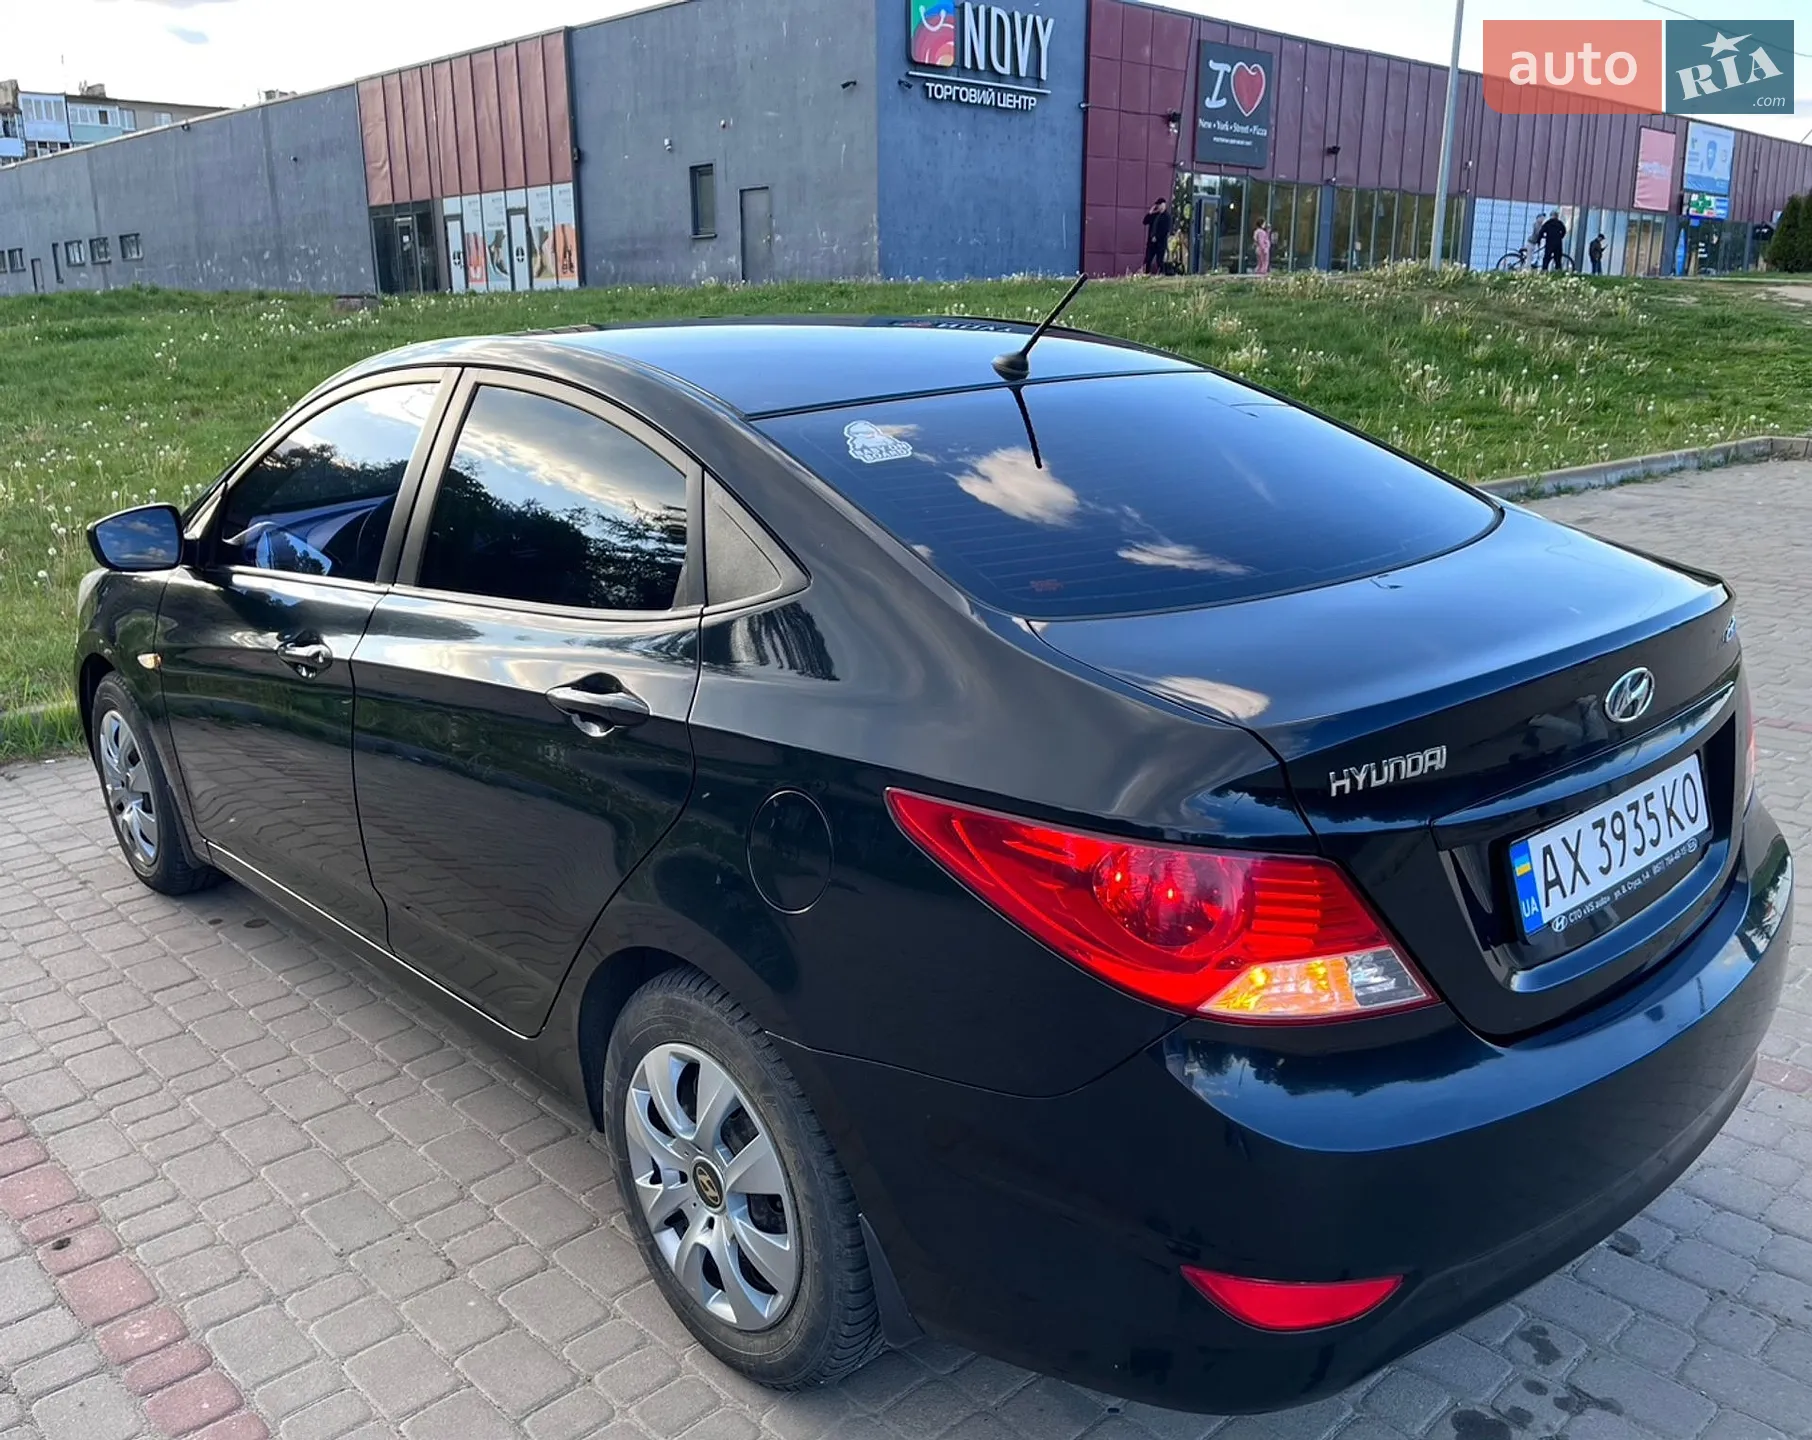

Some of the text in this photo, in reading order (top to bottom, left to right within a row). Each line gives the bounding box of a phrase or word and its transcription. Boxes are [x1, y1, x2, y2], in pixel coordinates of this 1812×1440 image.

[964, 1, 1055, 81] NOVY
[925, 82, 1037, 111] ТОРГОВИЙ ЦЕНТР
[1205, 59, 1231, 108] I
[1329, 745, 1448, 797] HYUNDAI
[1541, 829, 1591, 908] AX
[1592, 792, 1662, 876] 3935
[1522, 900, 1539, 918] UA
